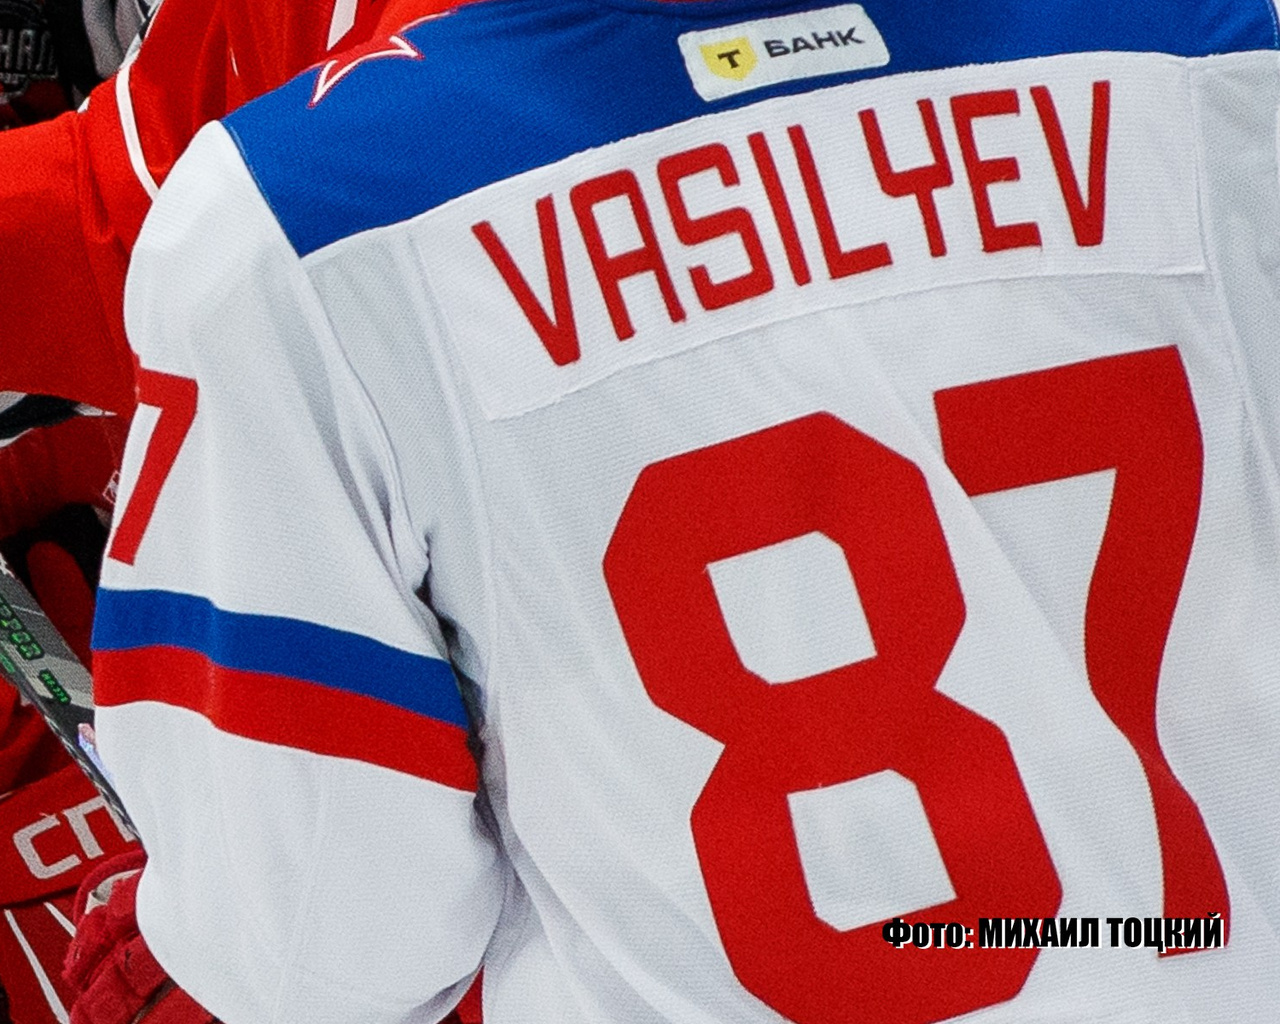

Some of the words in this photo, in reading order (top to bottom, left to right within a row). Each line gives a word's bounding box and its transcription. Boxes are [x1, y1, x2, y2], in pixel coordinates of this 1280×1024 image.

[717, 48, 741, 70] Т
[763, 27, 865, 58] БАНК
[470, 80, 1111, 367] VASILYEV
[601, 344, 1231, 1024] 87
